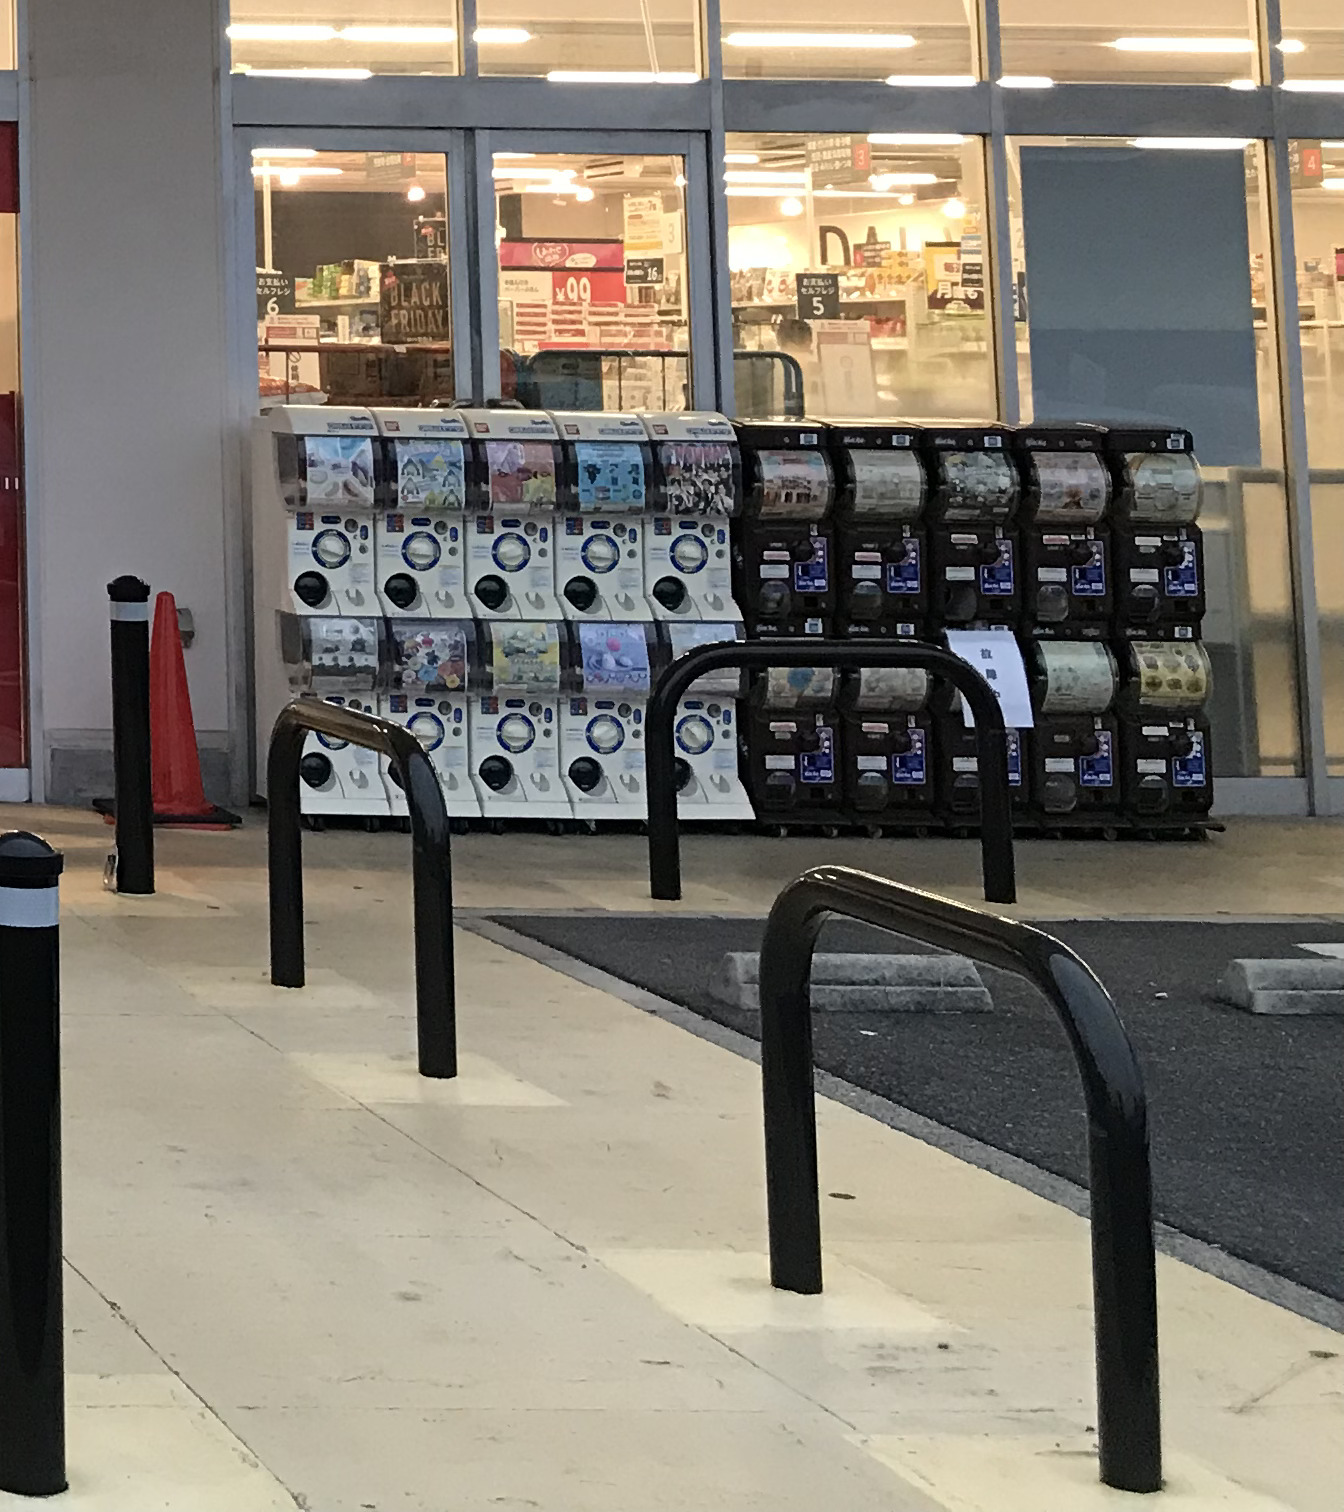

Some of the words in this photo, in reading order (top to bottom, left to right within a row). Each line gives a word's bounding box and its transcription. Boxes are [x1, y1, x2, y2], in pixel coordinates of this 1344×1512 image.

[1307, 155, 1317, 172] 4
[390, 282, 443, 306] BLACK
[266, 296, 279, 314] 6
[812, 297, 825, 316] 5
[390, 309, 446, 333] FRIDAY
